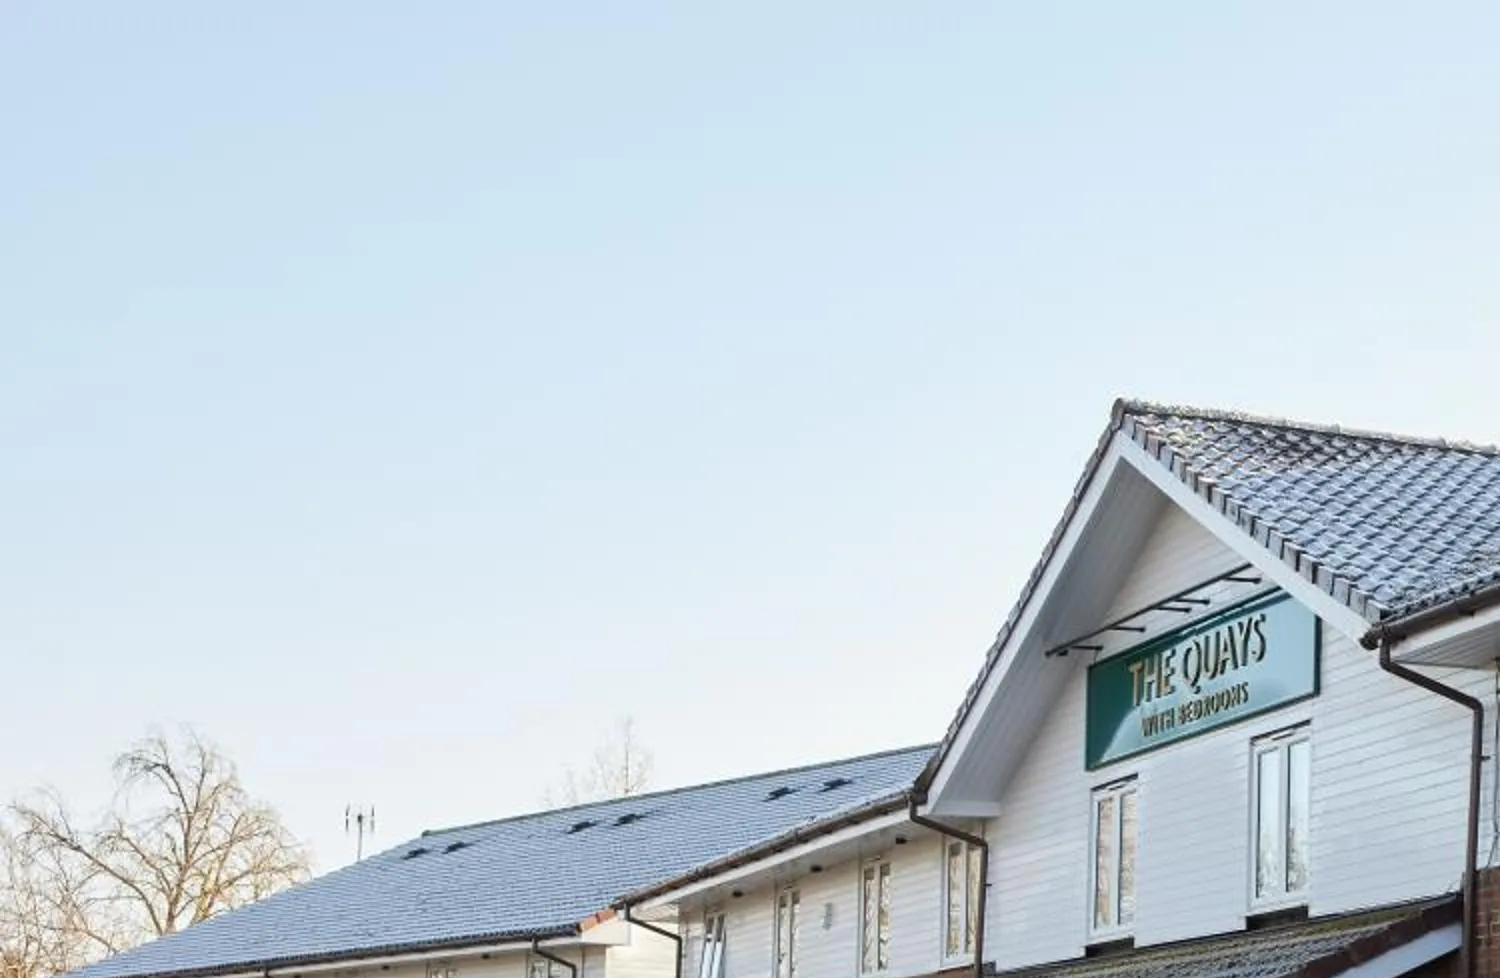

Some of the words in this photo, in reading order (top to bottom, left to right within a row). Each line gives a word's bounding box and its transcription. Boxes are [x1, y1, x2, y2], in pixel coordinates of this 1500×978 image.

[1129, 648, 1176, 706] THE
[1182, 612, 1267, 695] QUAYS
[1142, 706, 1175, 737] WITH
[1178, 681, 1249, 725] BEDROOMS
